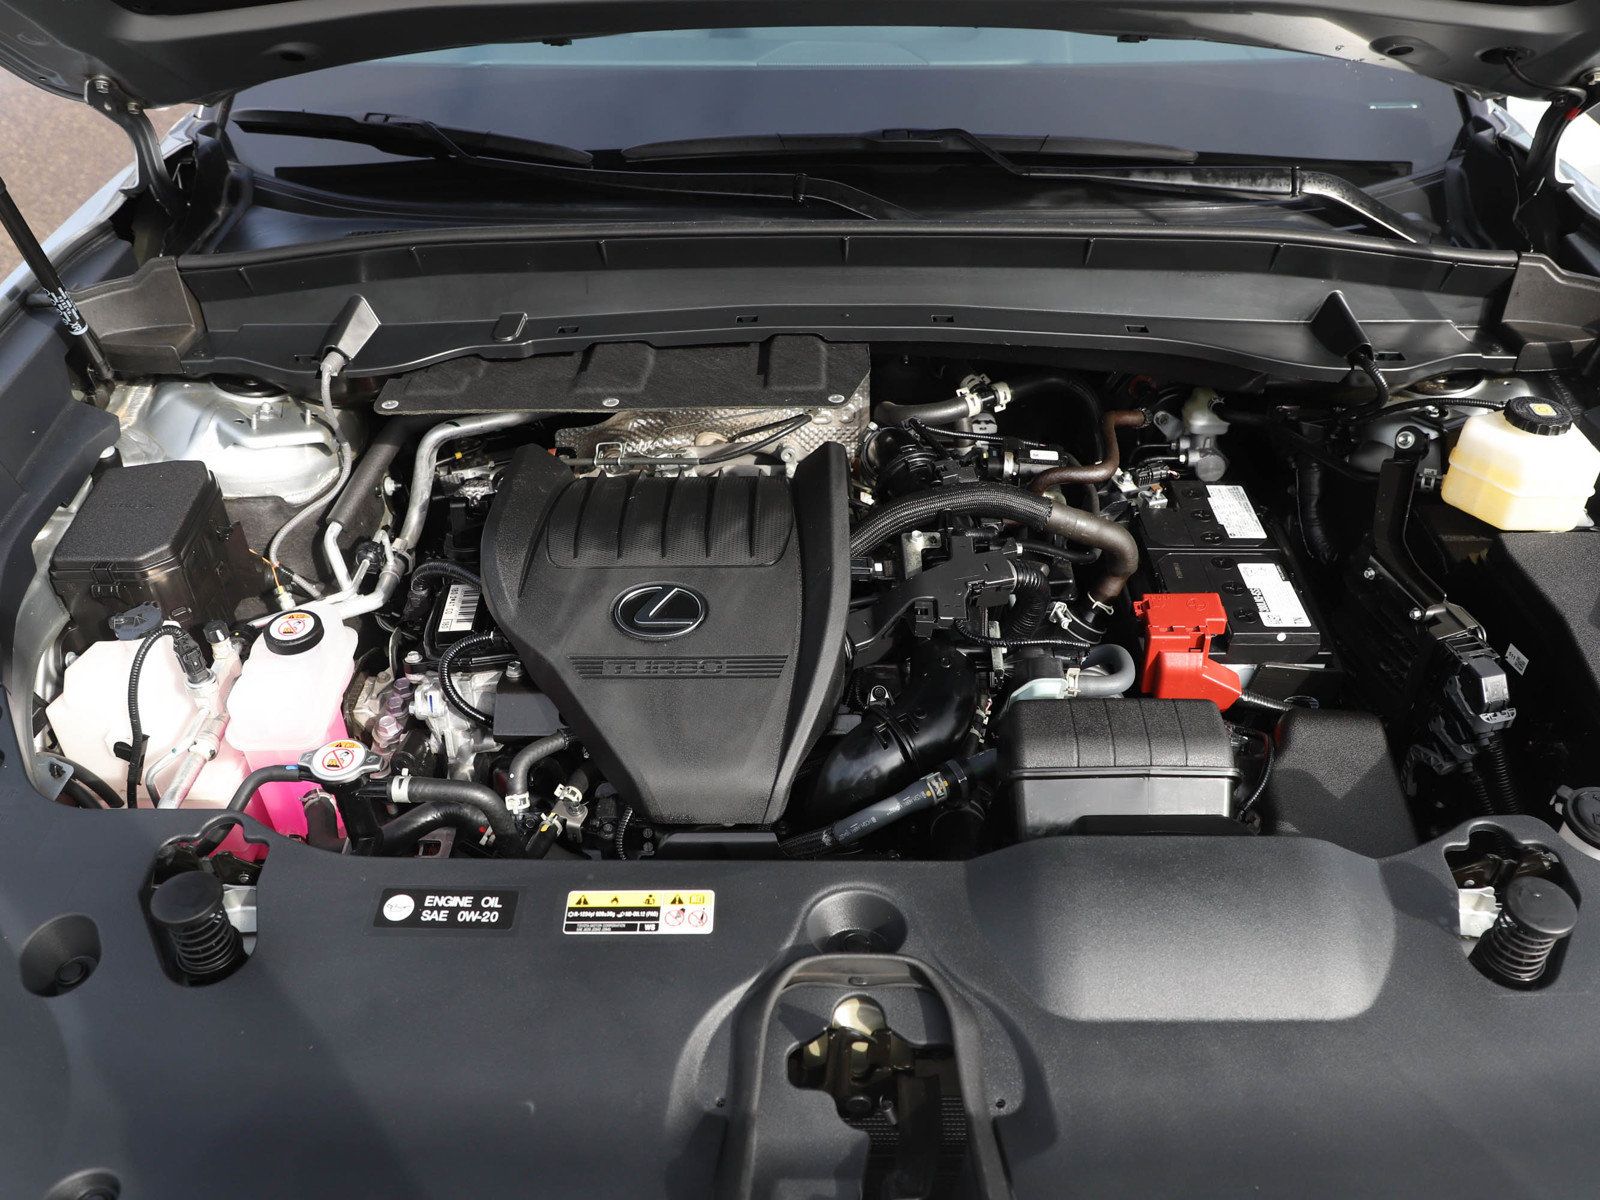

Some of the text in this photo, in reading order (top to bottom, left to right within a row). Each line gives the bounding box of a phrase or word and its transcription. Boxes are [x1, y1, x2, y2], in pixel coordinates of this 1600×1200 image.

[603, 660, 724, 675] TURBO
[424, 895, 503, 908] ENGINE OIL
[420, 909, 500, 923] SAE 0W-20
